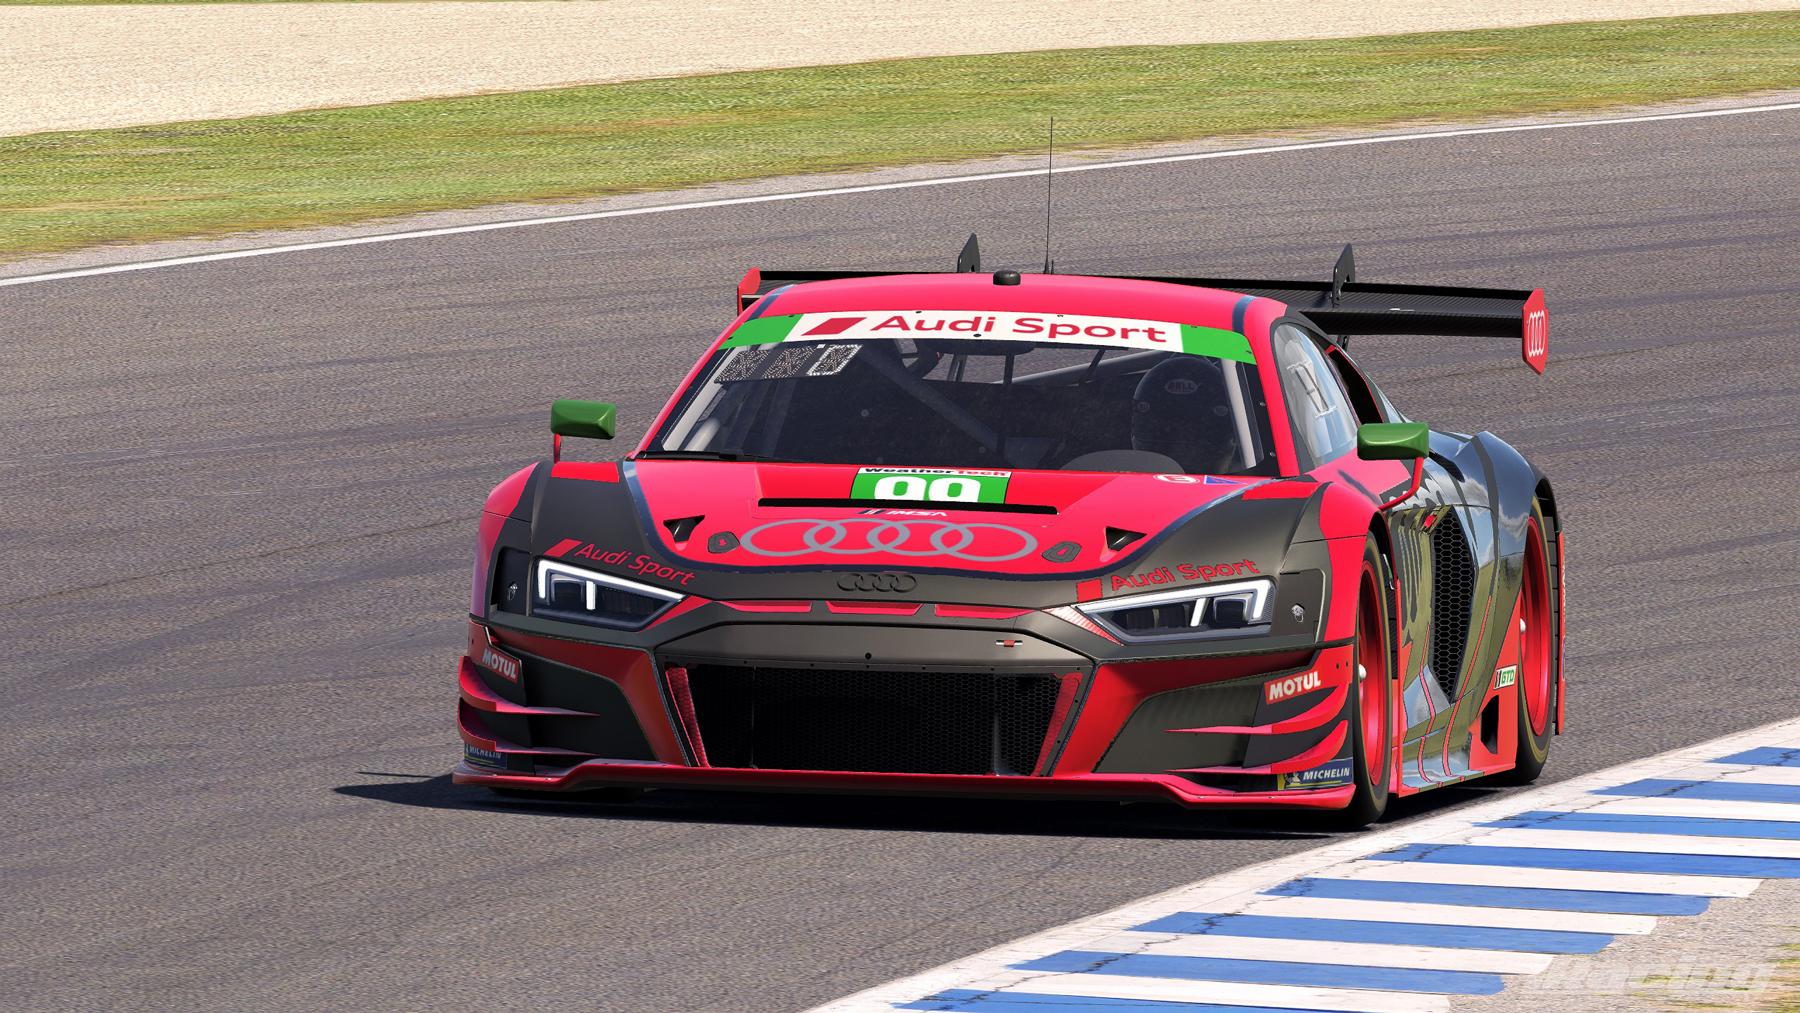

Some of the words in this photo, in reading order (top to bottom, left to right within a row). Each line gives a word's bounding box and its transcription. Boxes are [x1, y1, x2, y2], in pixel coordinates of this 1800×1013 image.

[871, 315, 996, 333] Audi
[1012, 317, 1167, 343] Sport
[864, 467, 1007, 477] WeatherTech
[873, 475, 981, 502] 00
[886, 510, 947, 518] IMSA
[574, 542, 632, 566] Audi
[628, 554, 696, 586] Sport
[1111, 566, 1177, 591] Audi
[1176, 558, 1262, 582] Sport
[482, 647, 517, 680] MOTUL
[1500, 668, 1515, 685] GTD
[1268, 670, 1322, 701] MOTUL
[1302, 767, 1351, 781] MICHELIN
